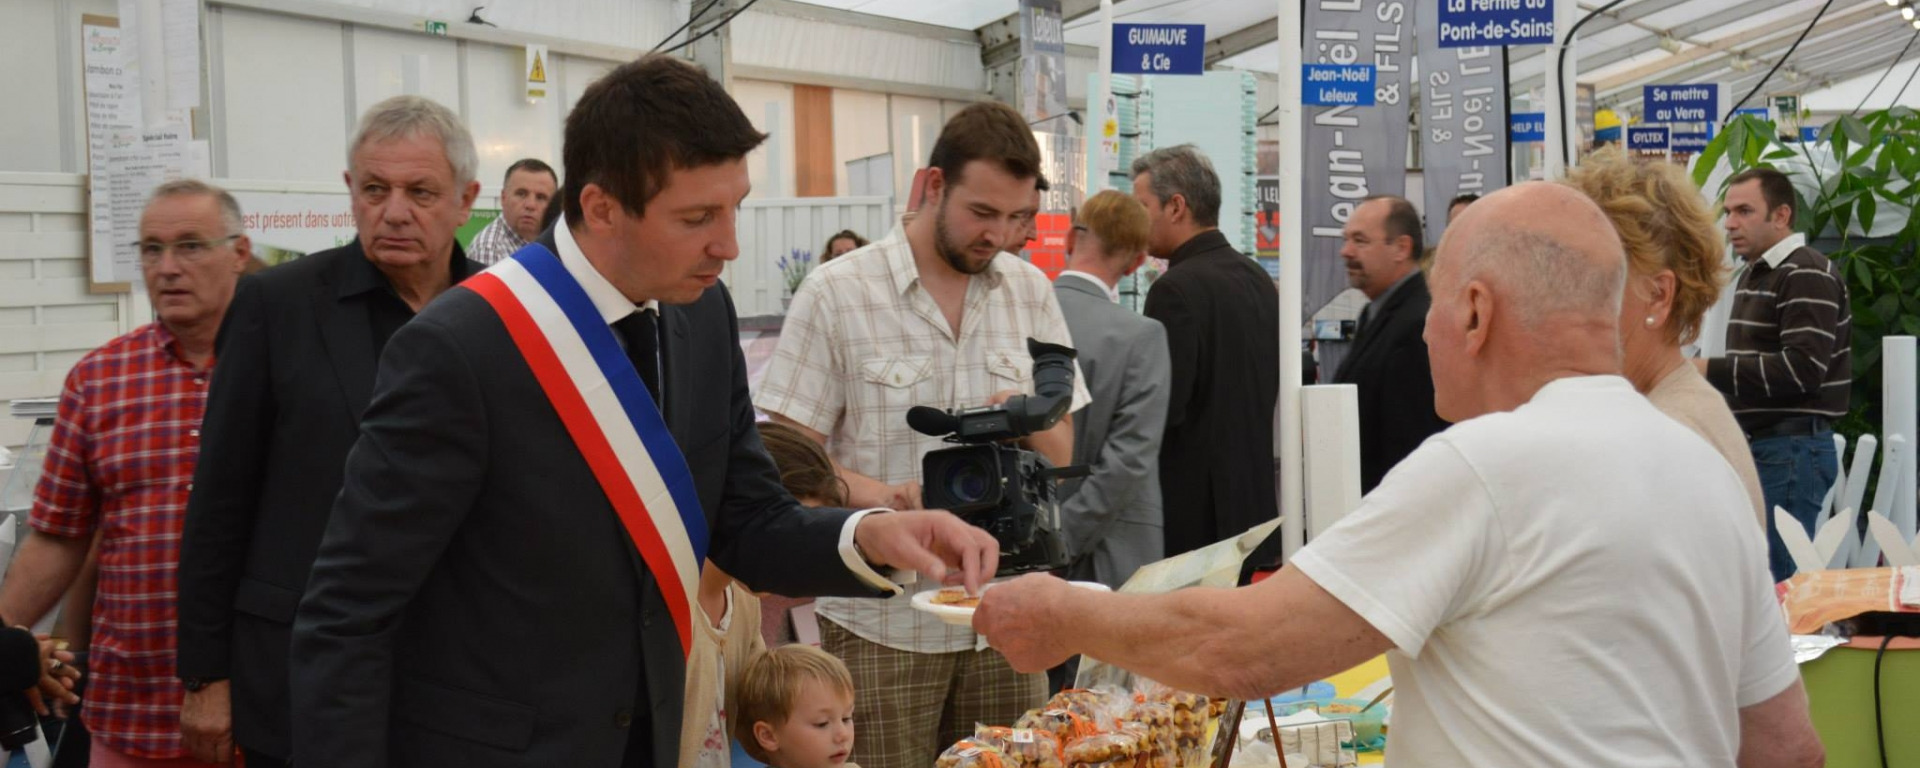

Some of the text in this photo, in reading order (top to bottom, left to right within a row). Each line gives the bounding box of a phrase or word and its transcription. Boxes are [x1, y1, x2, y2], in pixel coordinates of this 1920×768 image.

[1128, 27, 1187, 46] GUIMAUVE
[1440, 18, 1554, 41] Pont-de-Sains
[1374, 1, 1404, 105] & FILS
[1141, 53, 1171, 71] & Cie
[1307, 67, 1370, 82] Jean-Noël
[1319, 88, 1358, 103] Leleux
[1653, 87, 1709, 101] Se mettre
[1656, 106, 1705, 120] au Verre
[1632, 132, 1665, 144] GYLTEX
[262, 209, 303, 234] présent
[305, 209, 329, 229] dans
